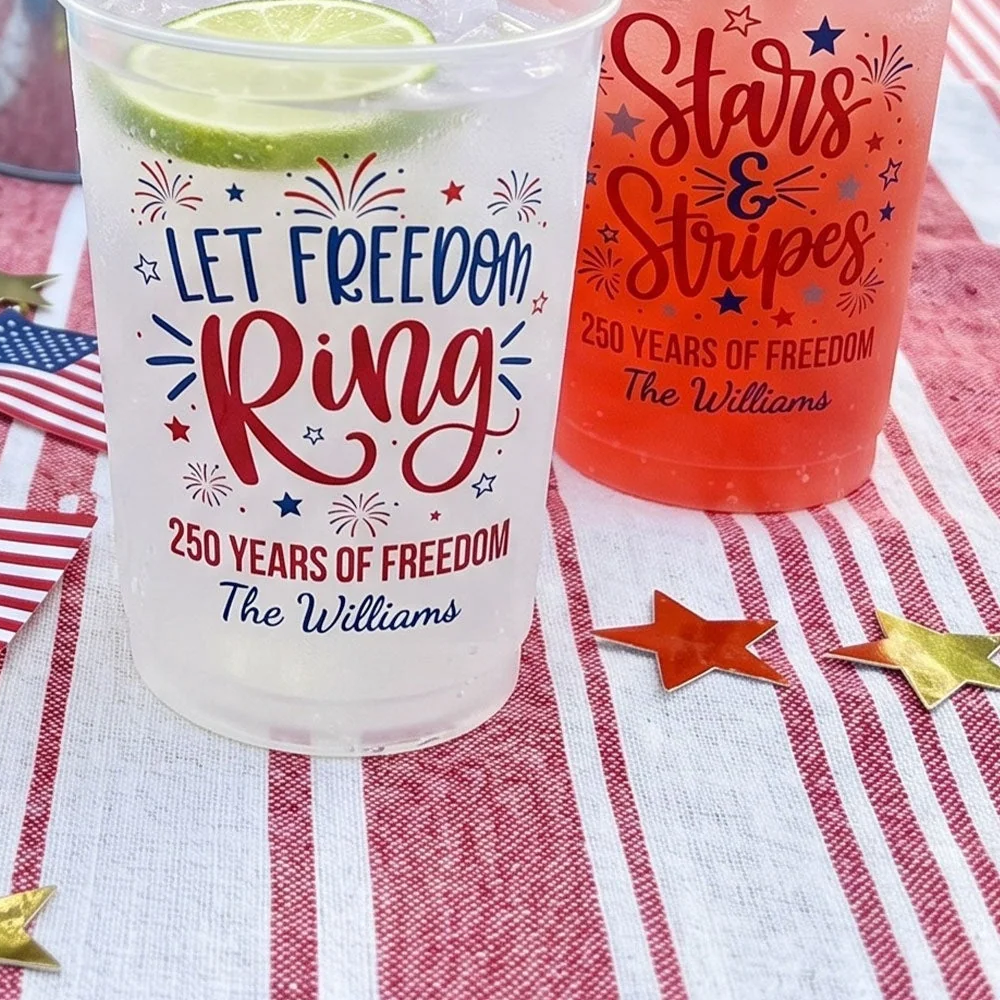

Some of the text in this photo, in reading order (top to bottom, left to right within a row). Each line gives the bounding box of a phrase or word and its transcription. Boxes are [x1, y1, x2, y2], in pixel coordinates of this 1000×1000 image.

[611, 12, 871, 167] Stars
[727, 151, 777, 220] &
[166, 226, 532, 306] LET FREEDOM
[606, 165, 875, 310] Stripes
[581, 311, 875, 371] 250 YEARS OF FREEDOM
[200, 310, 519, 493] Ring
[623, 367, 831, 414] The Williams
[169, 517, 511, 583] 250 YEARS OF FREEDOM
[219, 581, 461, 633] The Williams
